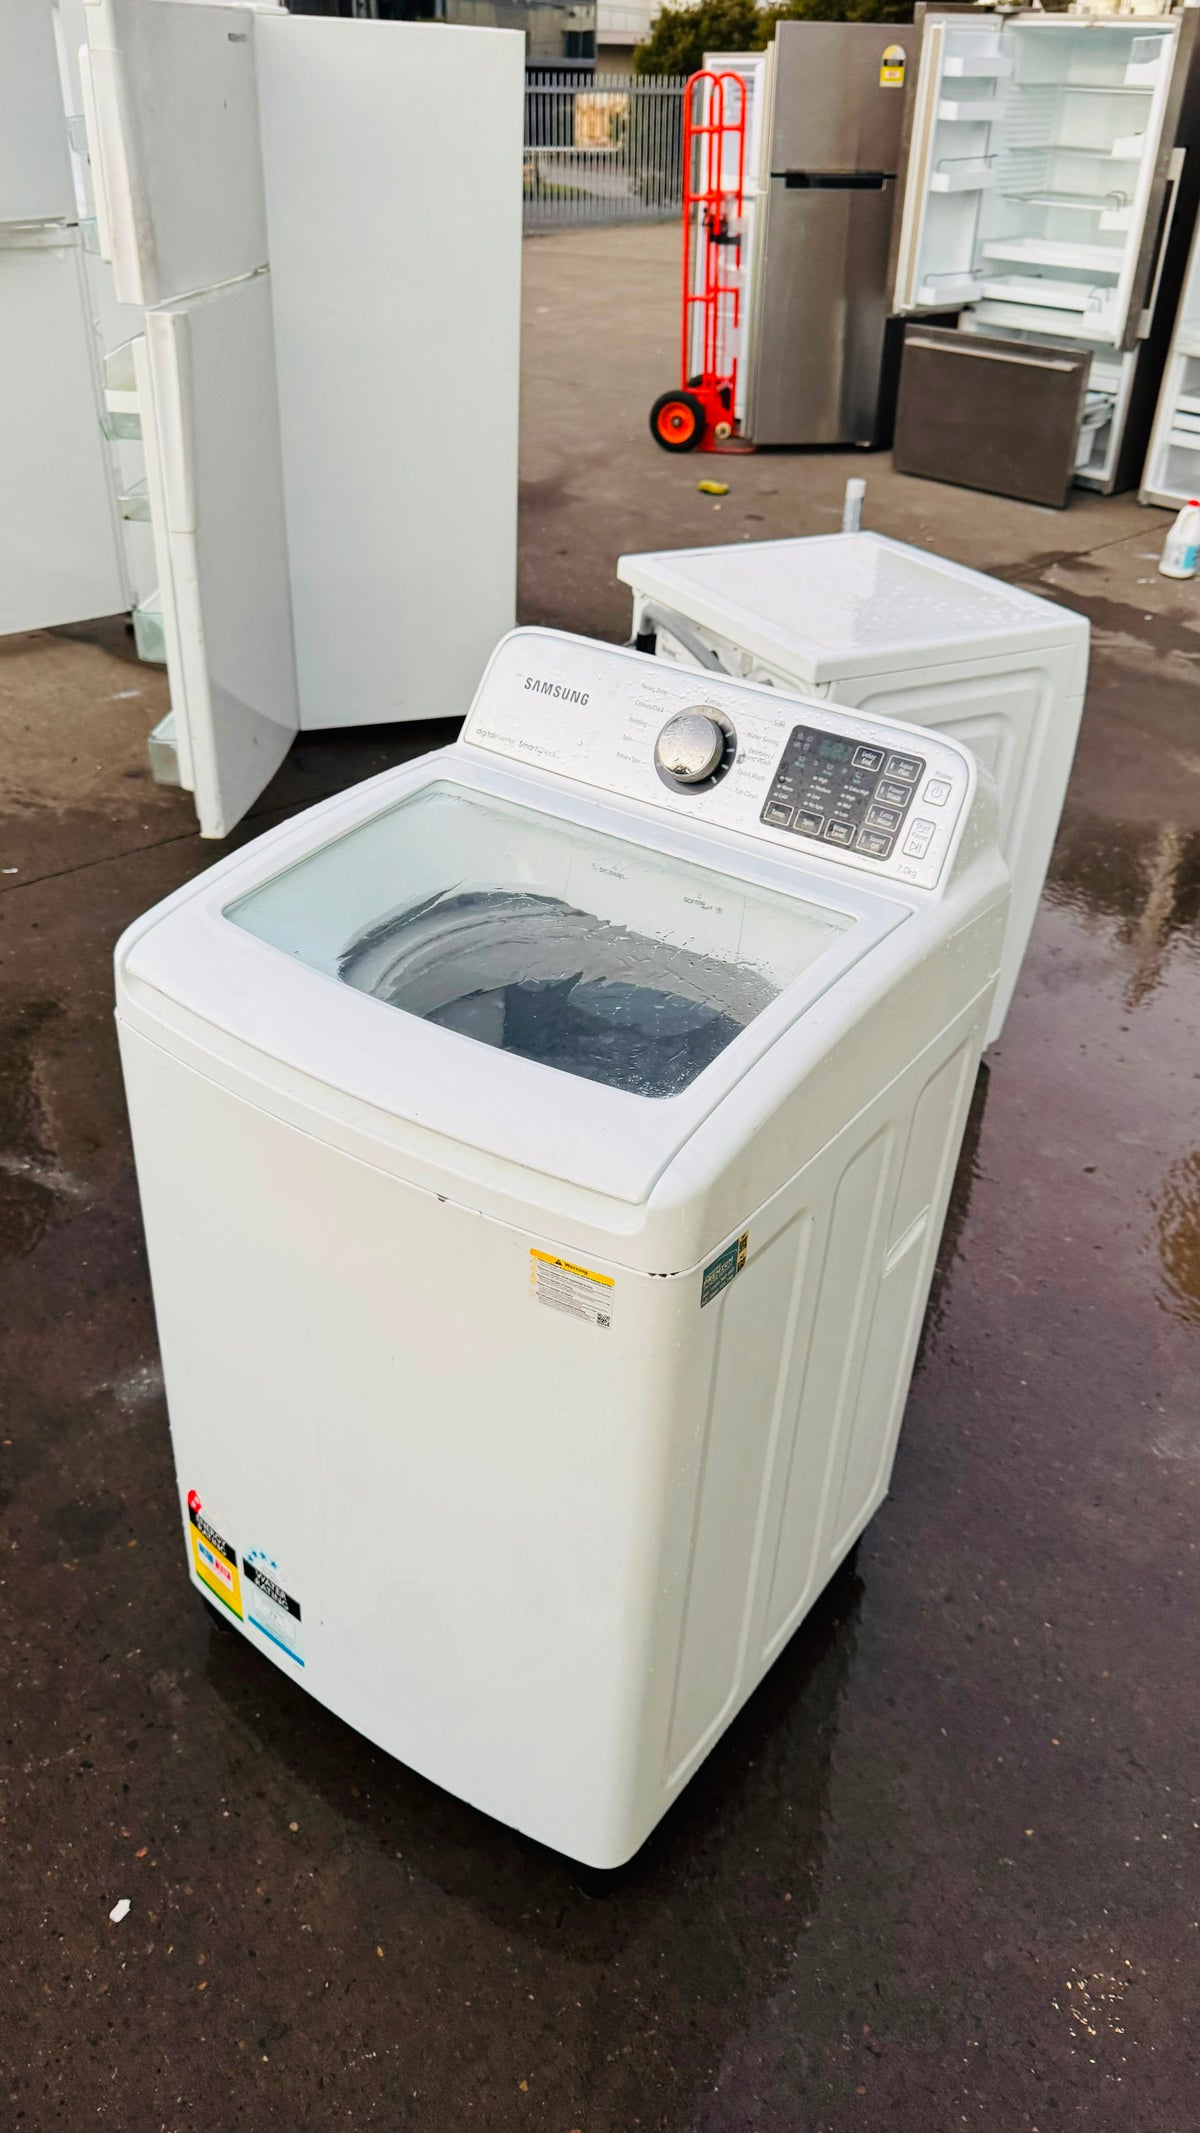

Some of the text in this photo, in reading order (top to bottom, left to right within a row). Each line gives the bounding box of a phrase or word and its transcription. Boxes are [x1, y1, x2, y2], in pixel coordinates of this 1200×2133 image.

[524, 677, 590, 706] SAMSUNG
[861, 751, 878, 761] Delay
[896, 864, 918, 878] 7.0kg
[564, 1262, 588, 1276] Warning
[255, 1569, 288, 1601] WATER
